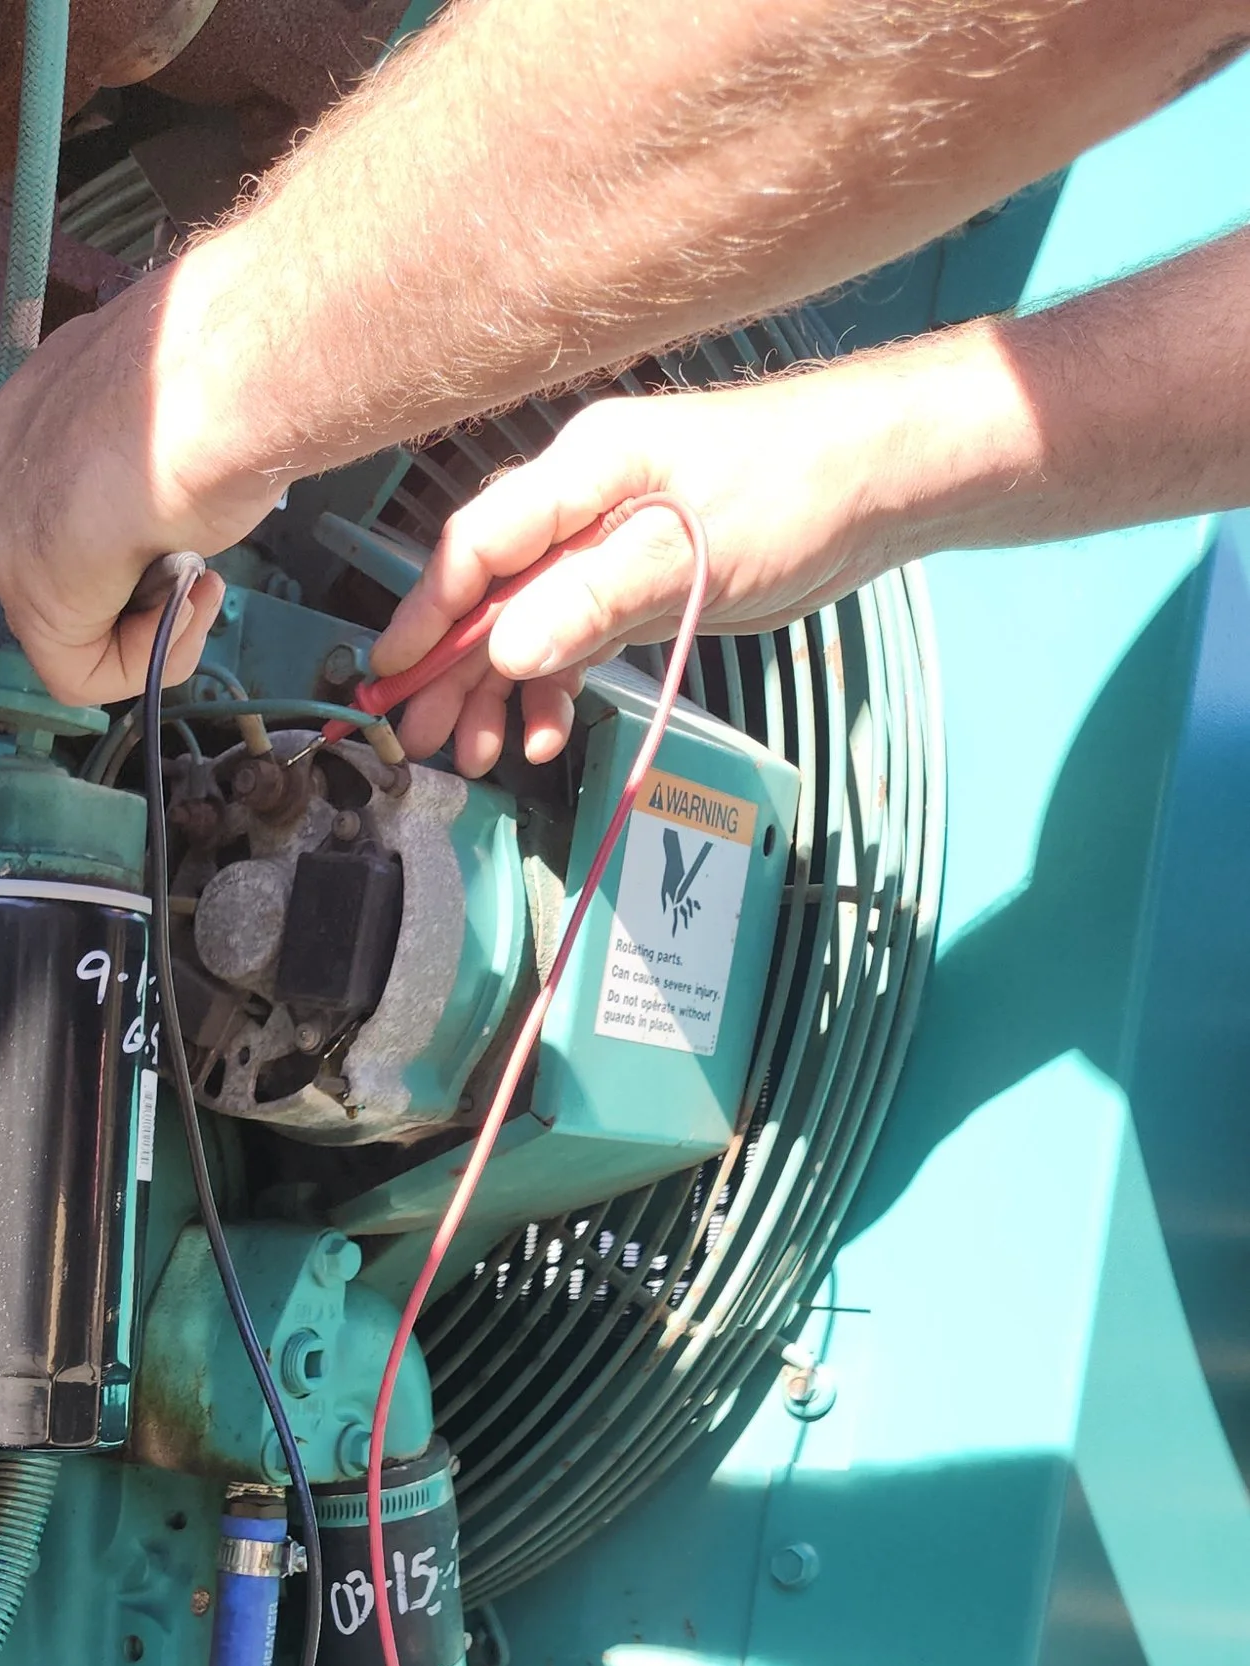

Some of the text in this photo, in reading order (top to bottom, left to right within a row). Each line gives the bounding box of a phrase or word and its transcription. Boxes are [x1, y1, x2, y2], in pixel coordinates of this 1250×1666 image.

[666, 785, 739, 834] WARNING
[616, 939, 683, 966] Rotating parts.
[612, 965, 720, 1002] Can cause severe injury.
[604, 1010, 676, 1032] guards in place.
[607, 989, 711, 1021] Do not operate without
